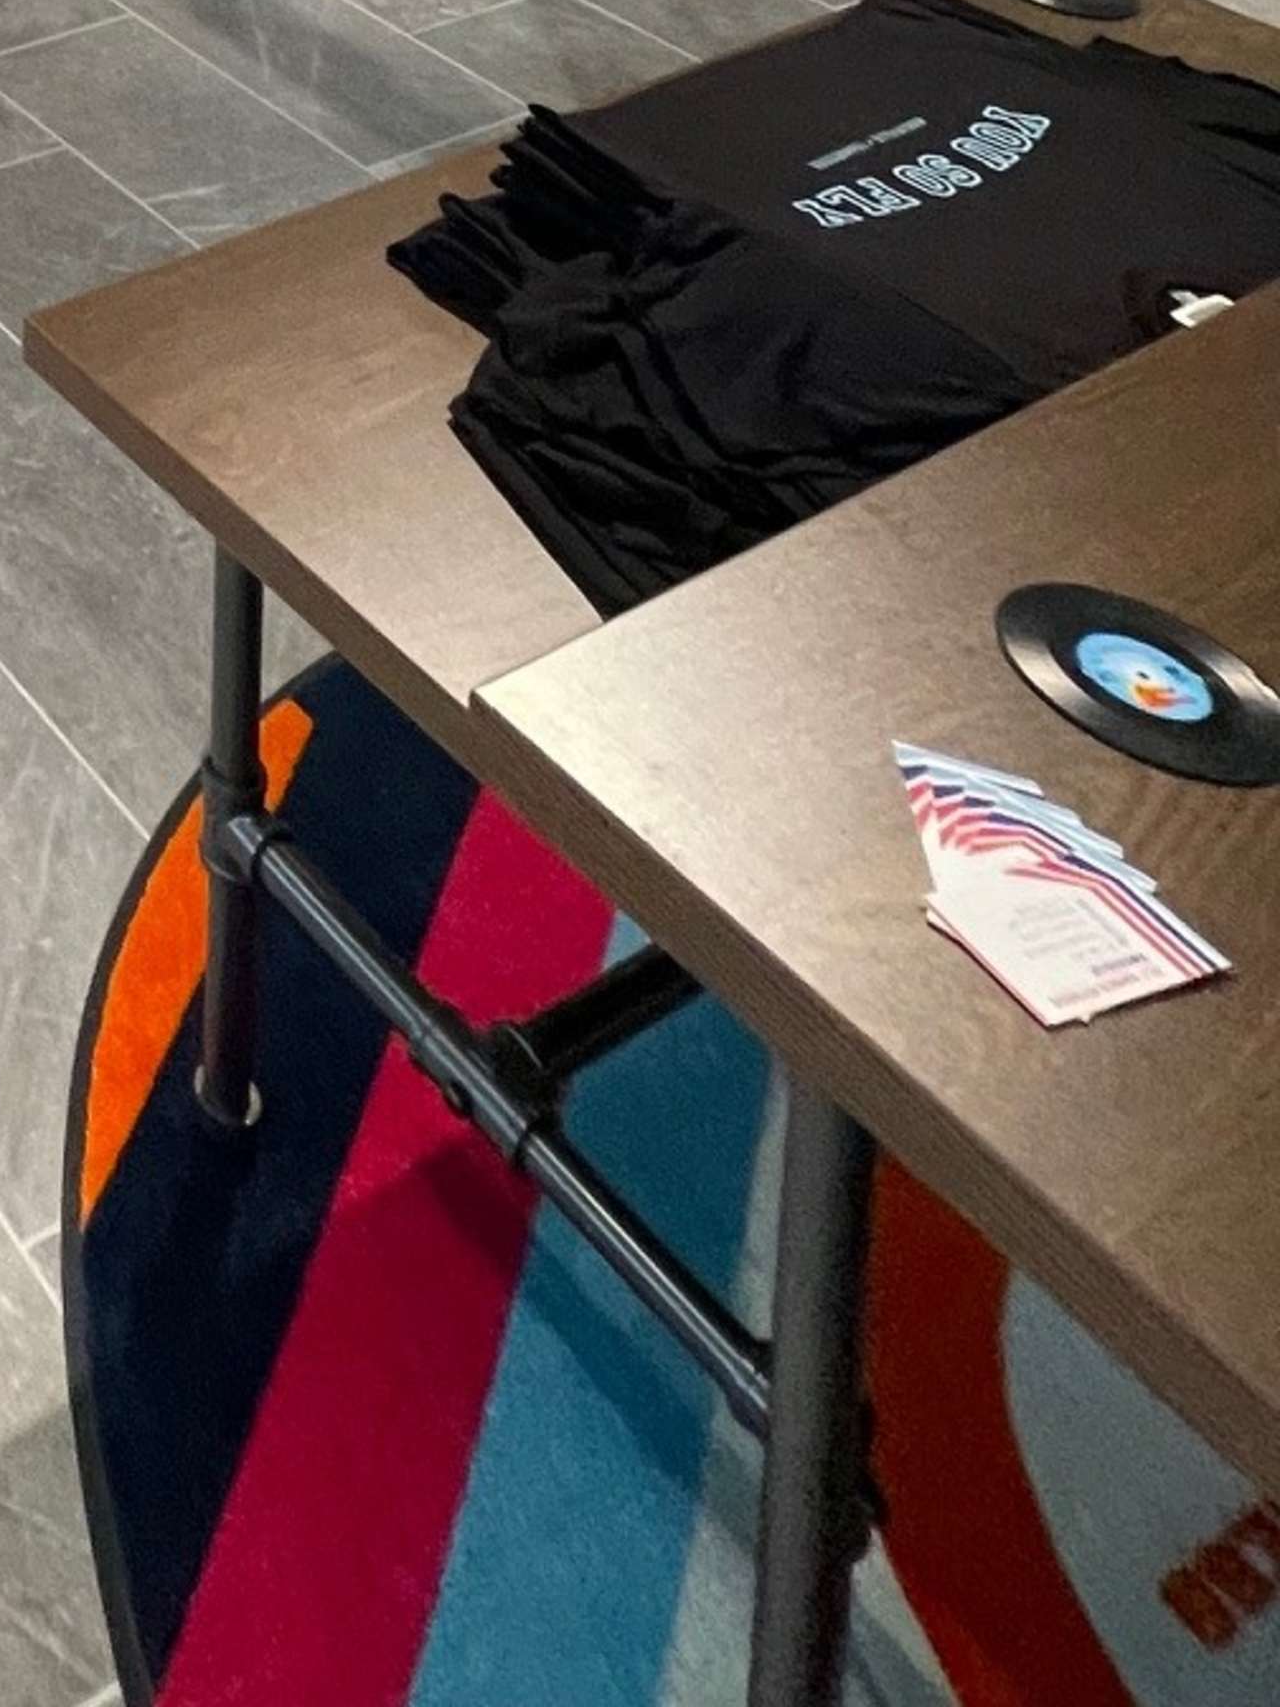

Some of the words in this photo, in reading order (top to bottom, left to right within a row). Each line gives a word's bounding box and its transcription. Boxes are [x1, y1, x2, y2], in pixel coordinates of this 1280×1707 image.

[950, 104, 1051, 171] YOU
[892, 153, 983, 198] SO
[791, 176, 923, 228] FLY
